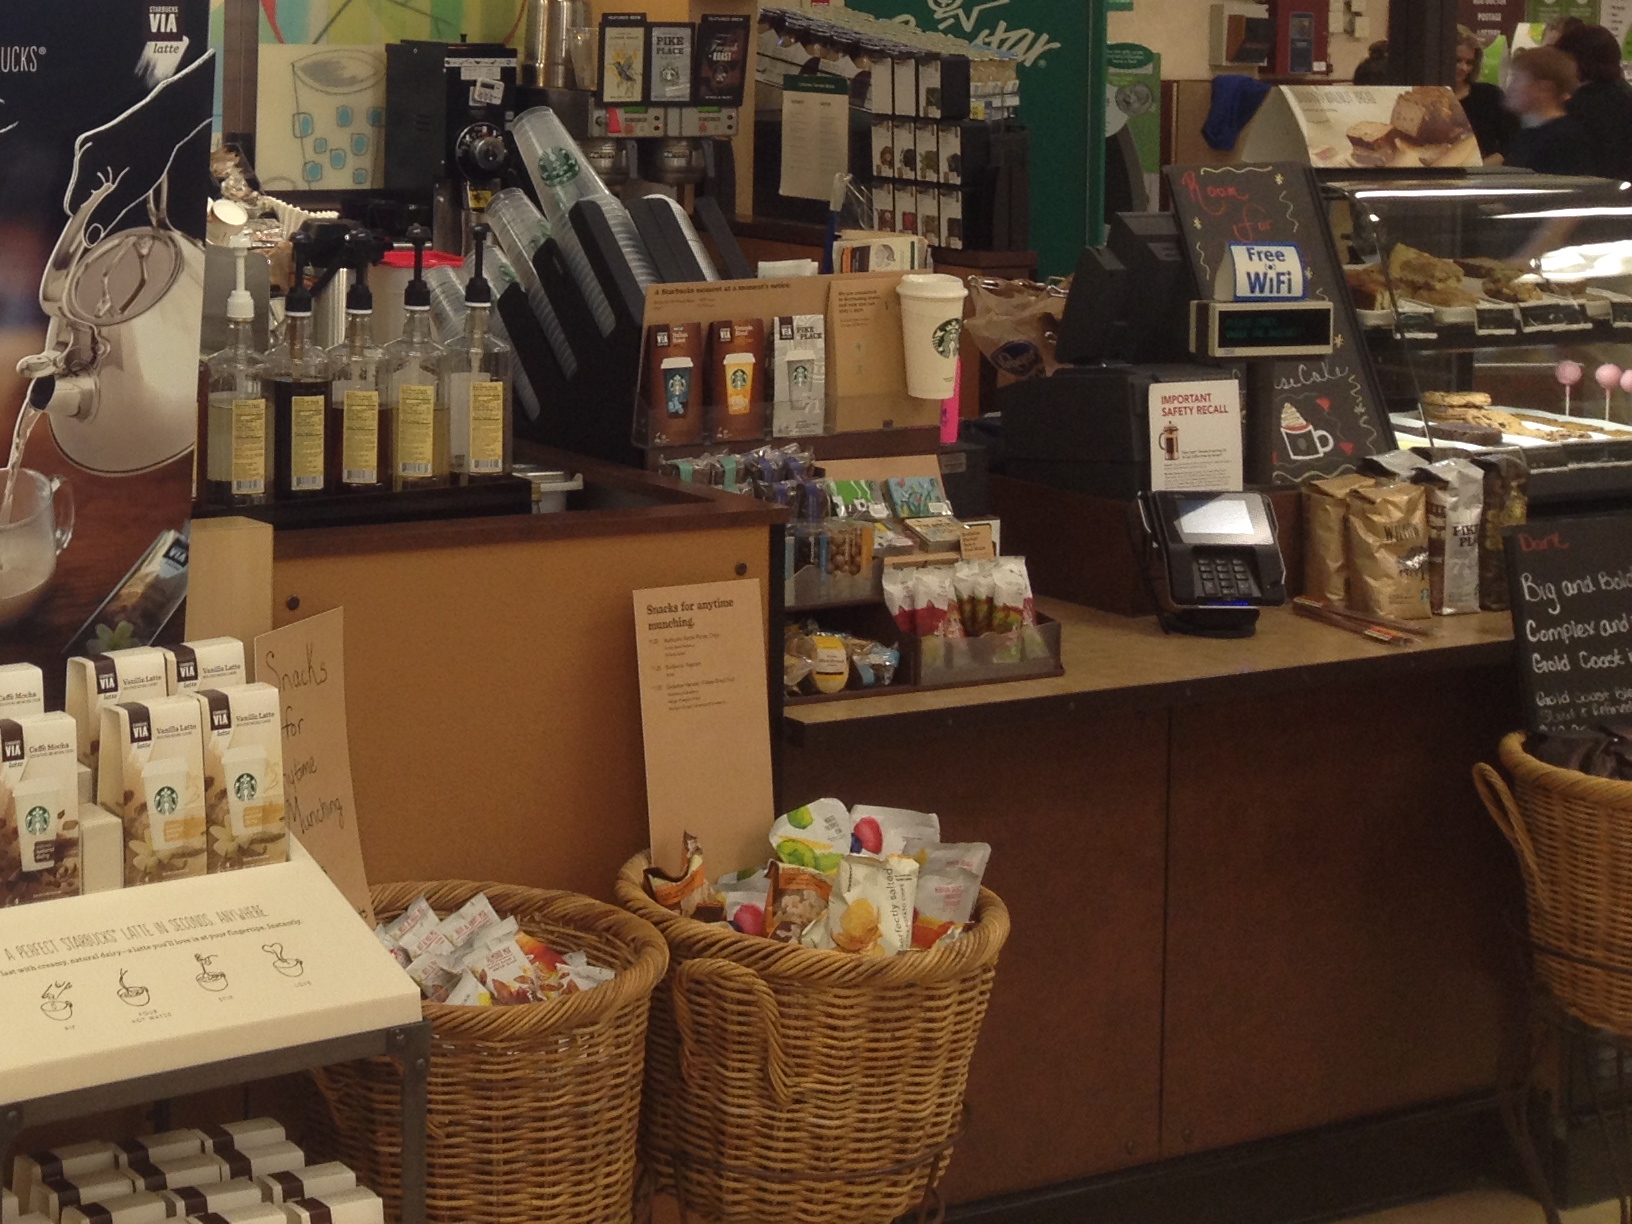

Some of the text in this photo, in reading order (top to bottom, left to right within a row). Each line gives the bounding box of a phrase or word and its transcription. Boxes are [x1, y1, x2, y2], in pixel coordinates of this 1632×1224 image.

[149, 14, 179, 33] VIA
[655, 36, 685, 46] PIKE
[152, 42, 180, 55] latte
[655, 47, 685, 55] PLACE
[1246, 247, 1286, 262] Free
[1246, 270, 1292, 295] WiFi
[661, 287, 694, 296] Starbucks
[795, 326, 815, 334] PIKE
[799, 332, 822, 340] PLACE
[1161, 393, 1212, 405] IMPORTANT
[1162, 405, 1228, 417] SAFETY RECALL
[1521, 572, 1561, 614] Big
[1561, 575, 1597, 596] and
[646, 598, 734, 616] Snacks for anytime
[1526, 613, 1630, 645] Complex and
[1532, 648, 1626, 674] Gold Coast
[179, 666, 195, 678] VIA
[202, 663, 241, 674] Vanilla Latte
[266, 642, 328, 696] Snacks
[100, 677, 115, 690] VIA
[122, 674, 162, 686] Vanilla Latte
[15, 691, 37, 700] Mocha
[1536, 691, 1570, 707] Gold
[212, 713, 229, 726] VIA
[235, 711, 275, 723] Vanilla Latte
[282, 705, 304, 741] for
[132, 726, 148, 738] VIA
[156, 723, 197, 735] Vanilla Latte
[5, 745, 21, 757] VIA
[47, 742, 69, 751] Mocha
[286, 796, 343, 834] Munching
[883, 867, 898, 901] salted
[4, 947, 16, 961] A
[16, 939, 60, 959] PERFECT
[120, 923, 155, 941] LATTE
[153, 921, 169, 935] IN
[0, 969, 17, 978] last
[17, 965, 37, 973] with
[37, 960, 69, 971] creamy,
[70, 954, 100, 964] natural
[132, 944, 151, 954] latte
[175, 937, 192, 946] love
[209, 932, 227, 942] your
